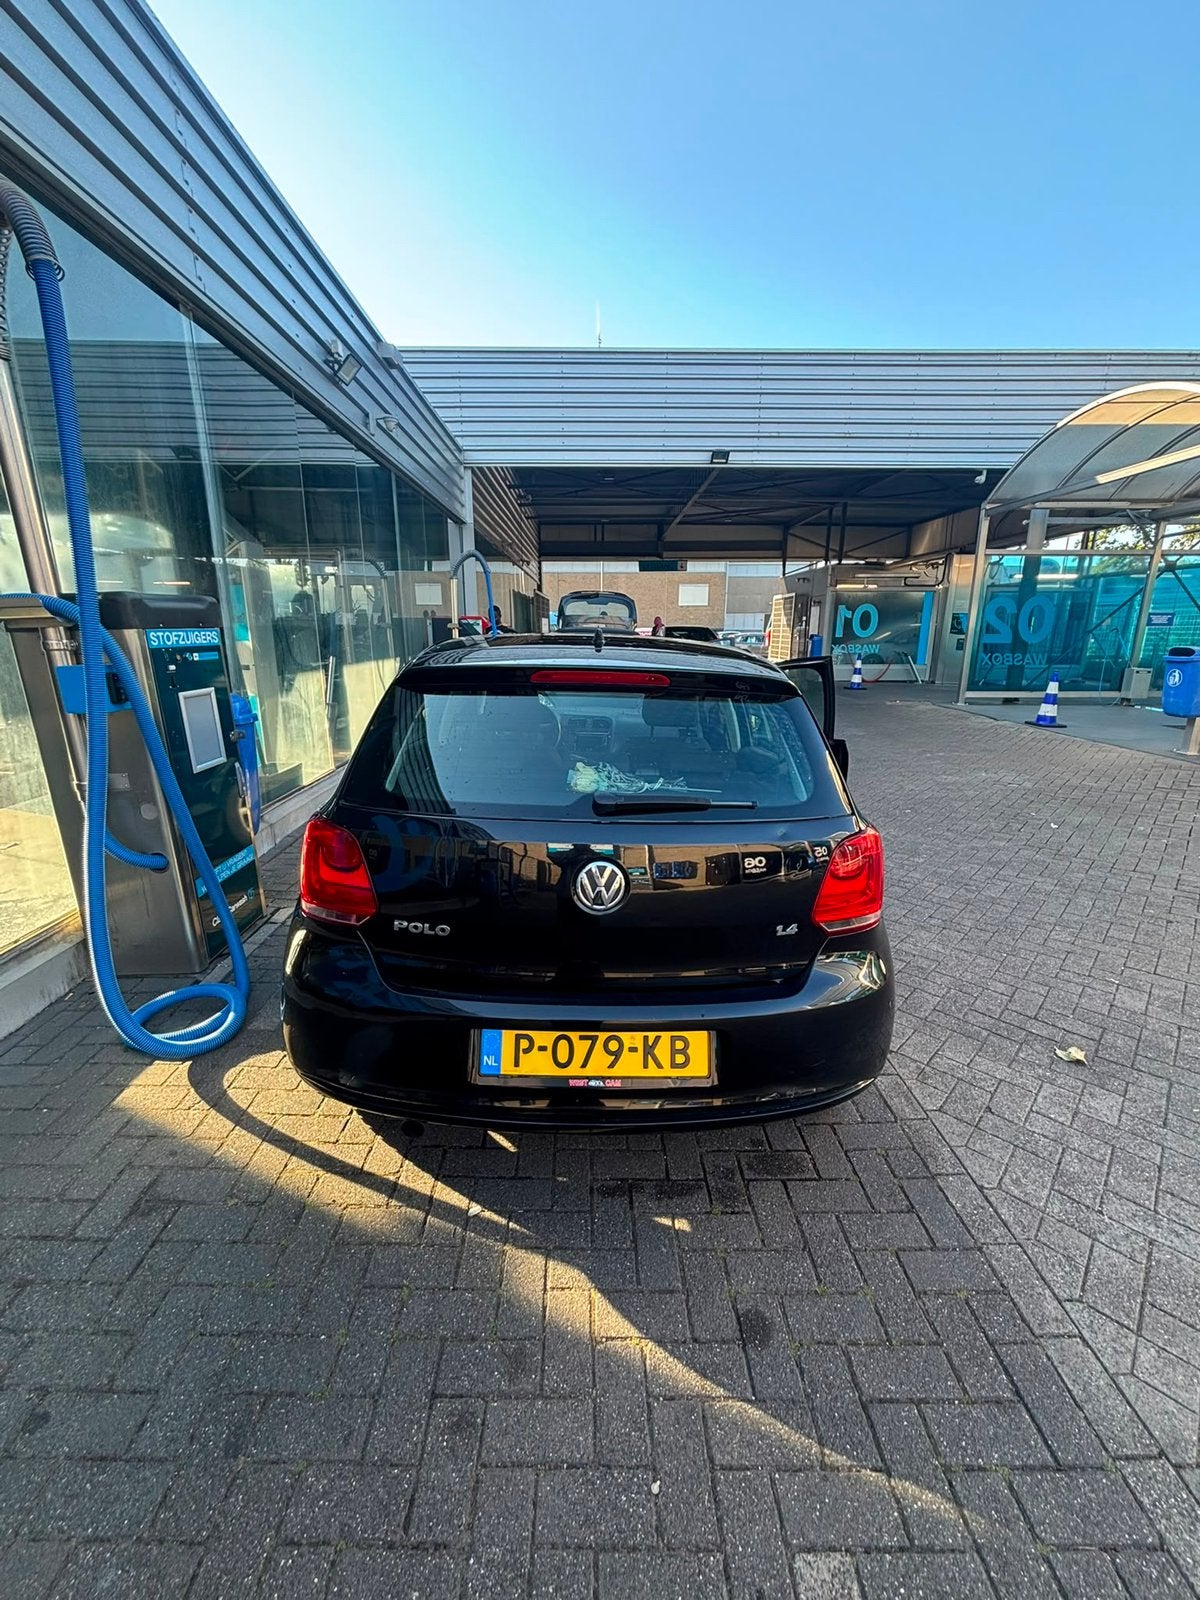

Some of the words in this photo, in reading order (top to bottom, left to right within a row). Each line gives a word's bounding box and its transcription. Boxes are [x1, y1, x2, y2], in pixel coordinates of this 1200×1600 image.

[149, 631, 219, 646] STOFZUIGERS
[393, 919, 451, 936] POLO
[513, 1033, 691, 1069] P-079-KB
[483, 1055, 498, 1066] NL
